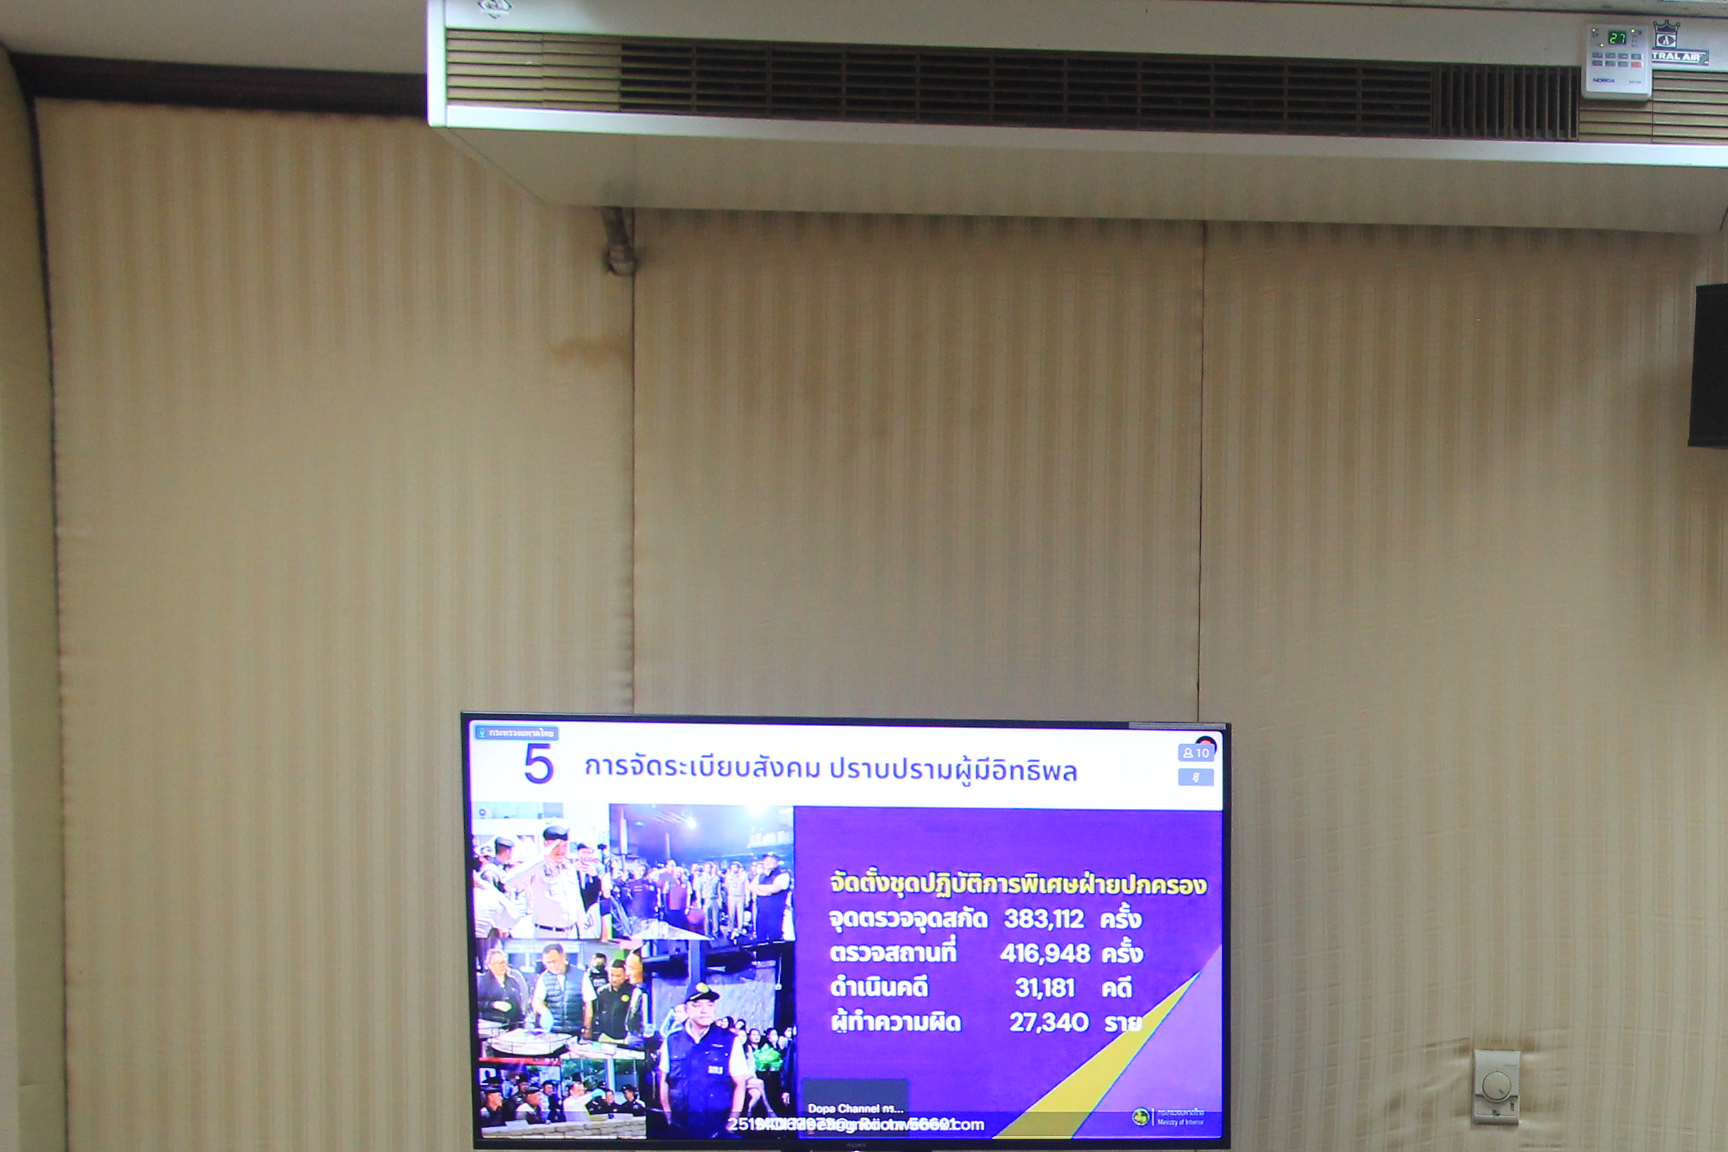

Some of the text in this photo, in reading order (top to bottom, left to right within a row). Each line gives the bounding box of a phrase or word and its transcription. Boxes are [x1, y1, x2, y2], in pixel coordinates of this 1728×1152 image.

[1609, 33, 1626, 44] 27
[1682, 53, 1701, 62] AIR
[524, 742, 554, 784] 5
[1196, 747, 1210, 759] 10
[585, 752, 1078, 788] การจัดระเบียบสังคม ปราบปรามผู้มีอิทธิพล
[829, 867, 1208, 899] จัดตั้งชุดปฏิบัติการพิเศษฝ่ายปกครอง
[828, 902, 1143, 934] จุดตรวจจุดสกัด 383,112 ครั้ง
[829, 934, 1144, 966] ตรวจสถานที่ 416,948 ครั้ง
[829, 973, 1133, 1000] ดำเนินคดี 31,181 คดี
[831, 1007, 1143, 1035] ผู้ทำความผิด 27,340 ราย
[808, 1103, 836, 1115] Dopa
[838, 1103, 880, 1113] Channel
